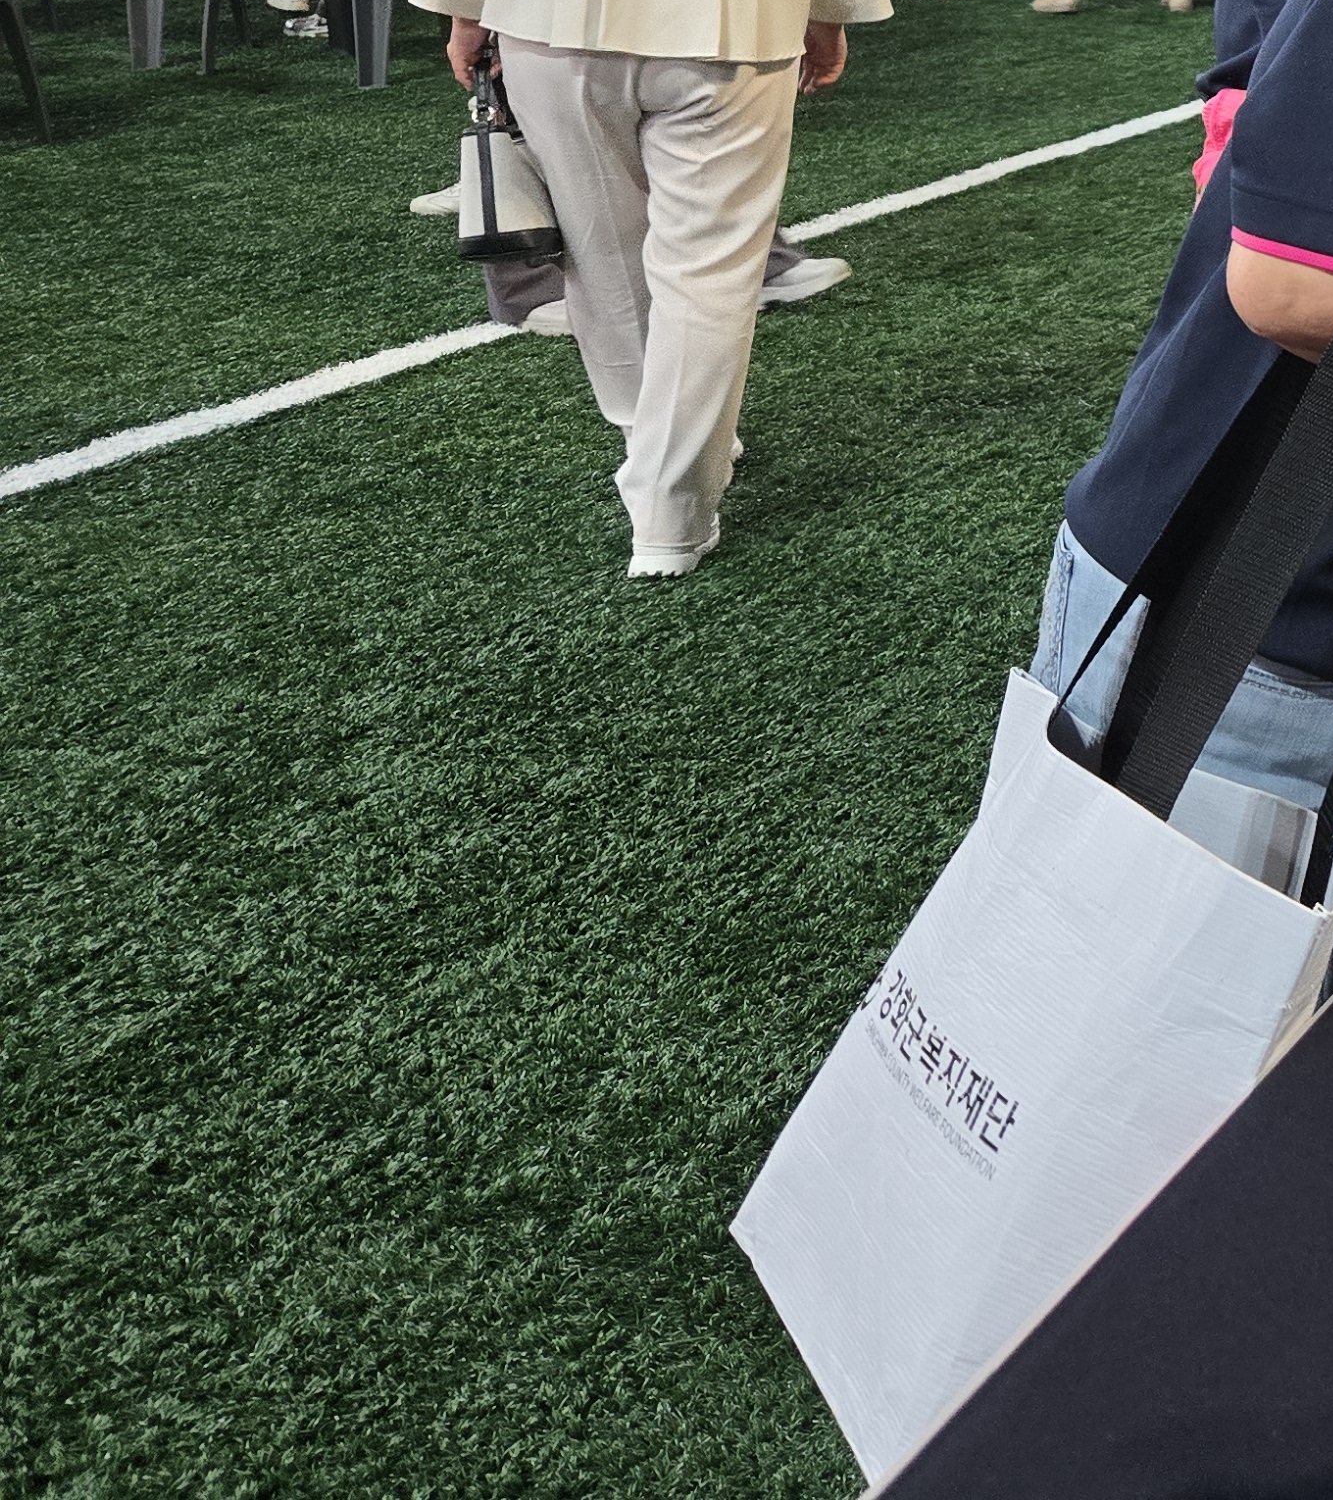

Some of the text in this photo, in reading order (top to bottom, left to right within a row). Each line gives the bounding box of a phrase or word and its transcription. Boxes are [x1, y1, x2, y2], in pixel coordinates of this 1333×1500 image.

[879, 968, 1019, 1152] 강화군복지재단
[885, 1049, 911, 1094] COUNTY
[908, 1083, 941, 1128] WELFARE
[937, 1116, 998, 1182] FOUNDATION
